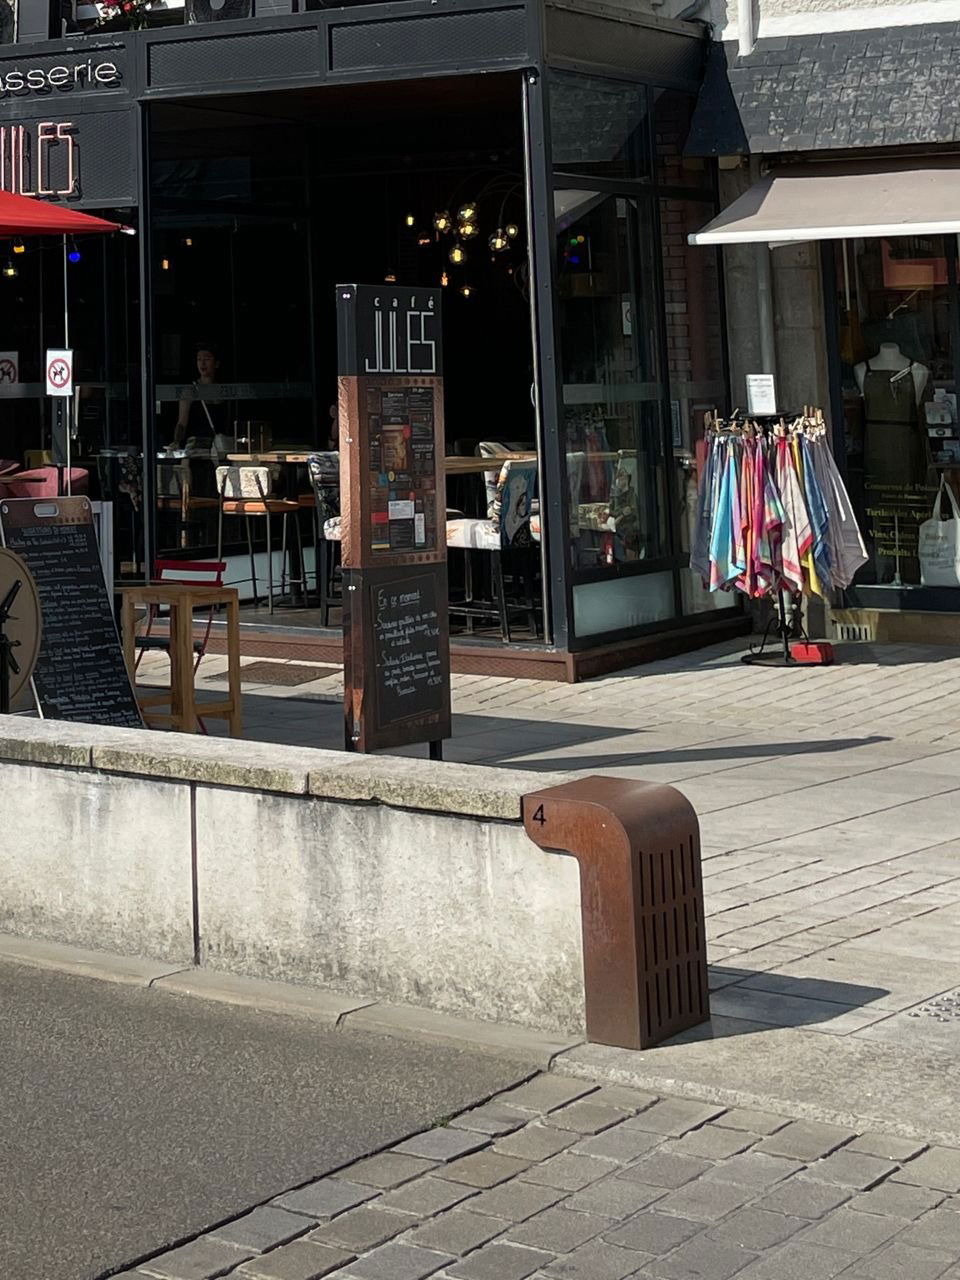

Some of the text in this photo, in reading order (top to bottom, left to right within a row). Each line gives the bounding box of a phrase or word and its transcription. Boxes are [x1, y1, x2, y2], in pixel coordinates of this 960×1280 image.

[374, 295, 434, 309] café
[365, 310, 436, 374] JULES
[532, 803, 547, 827] 4
